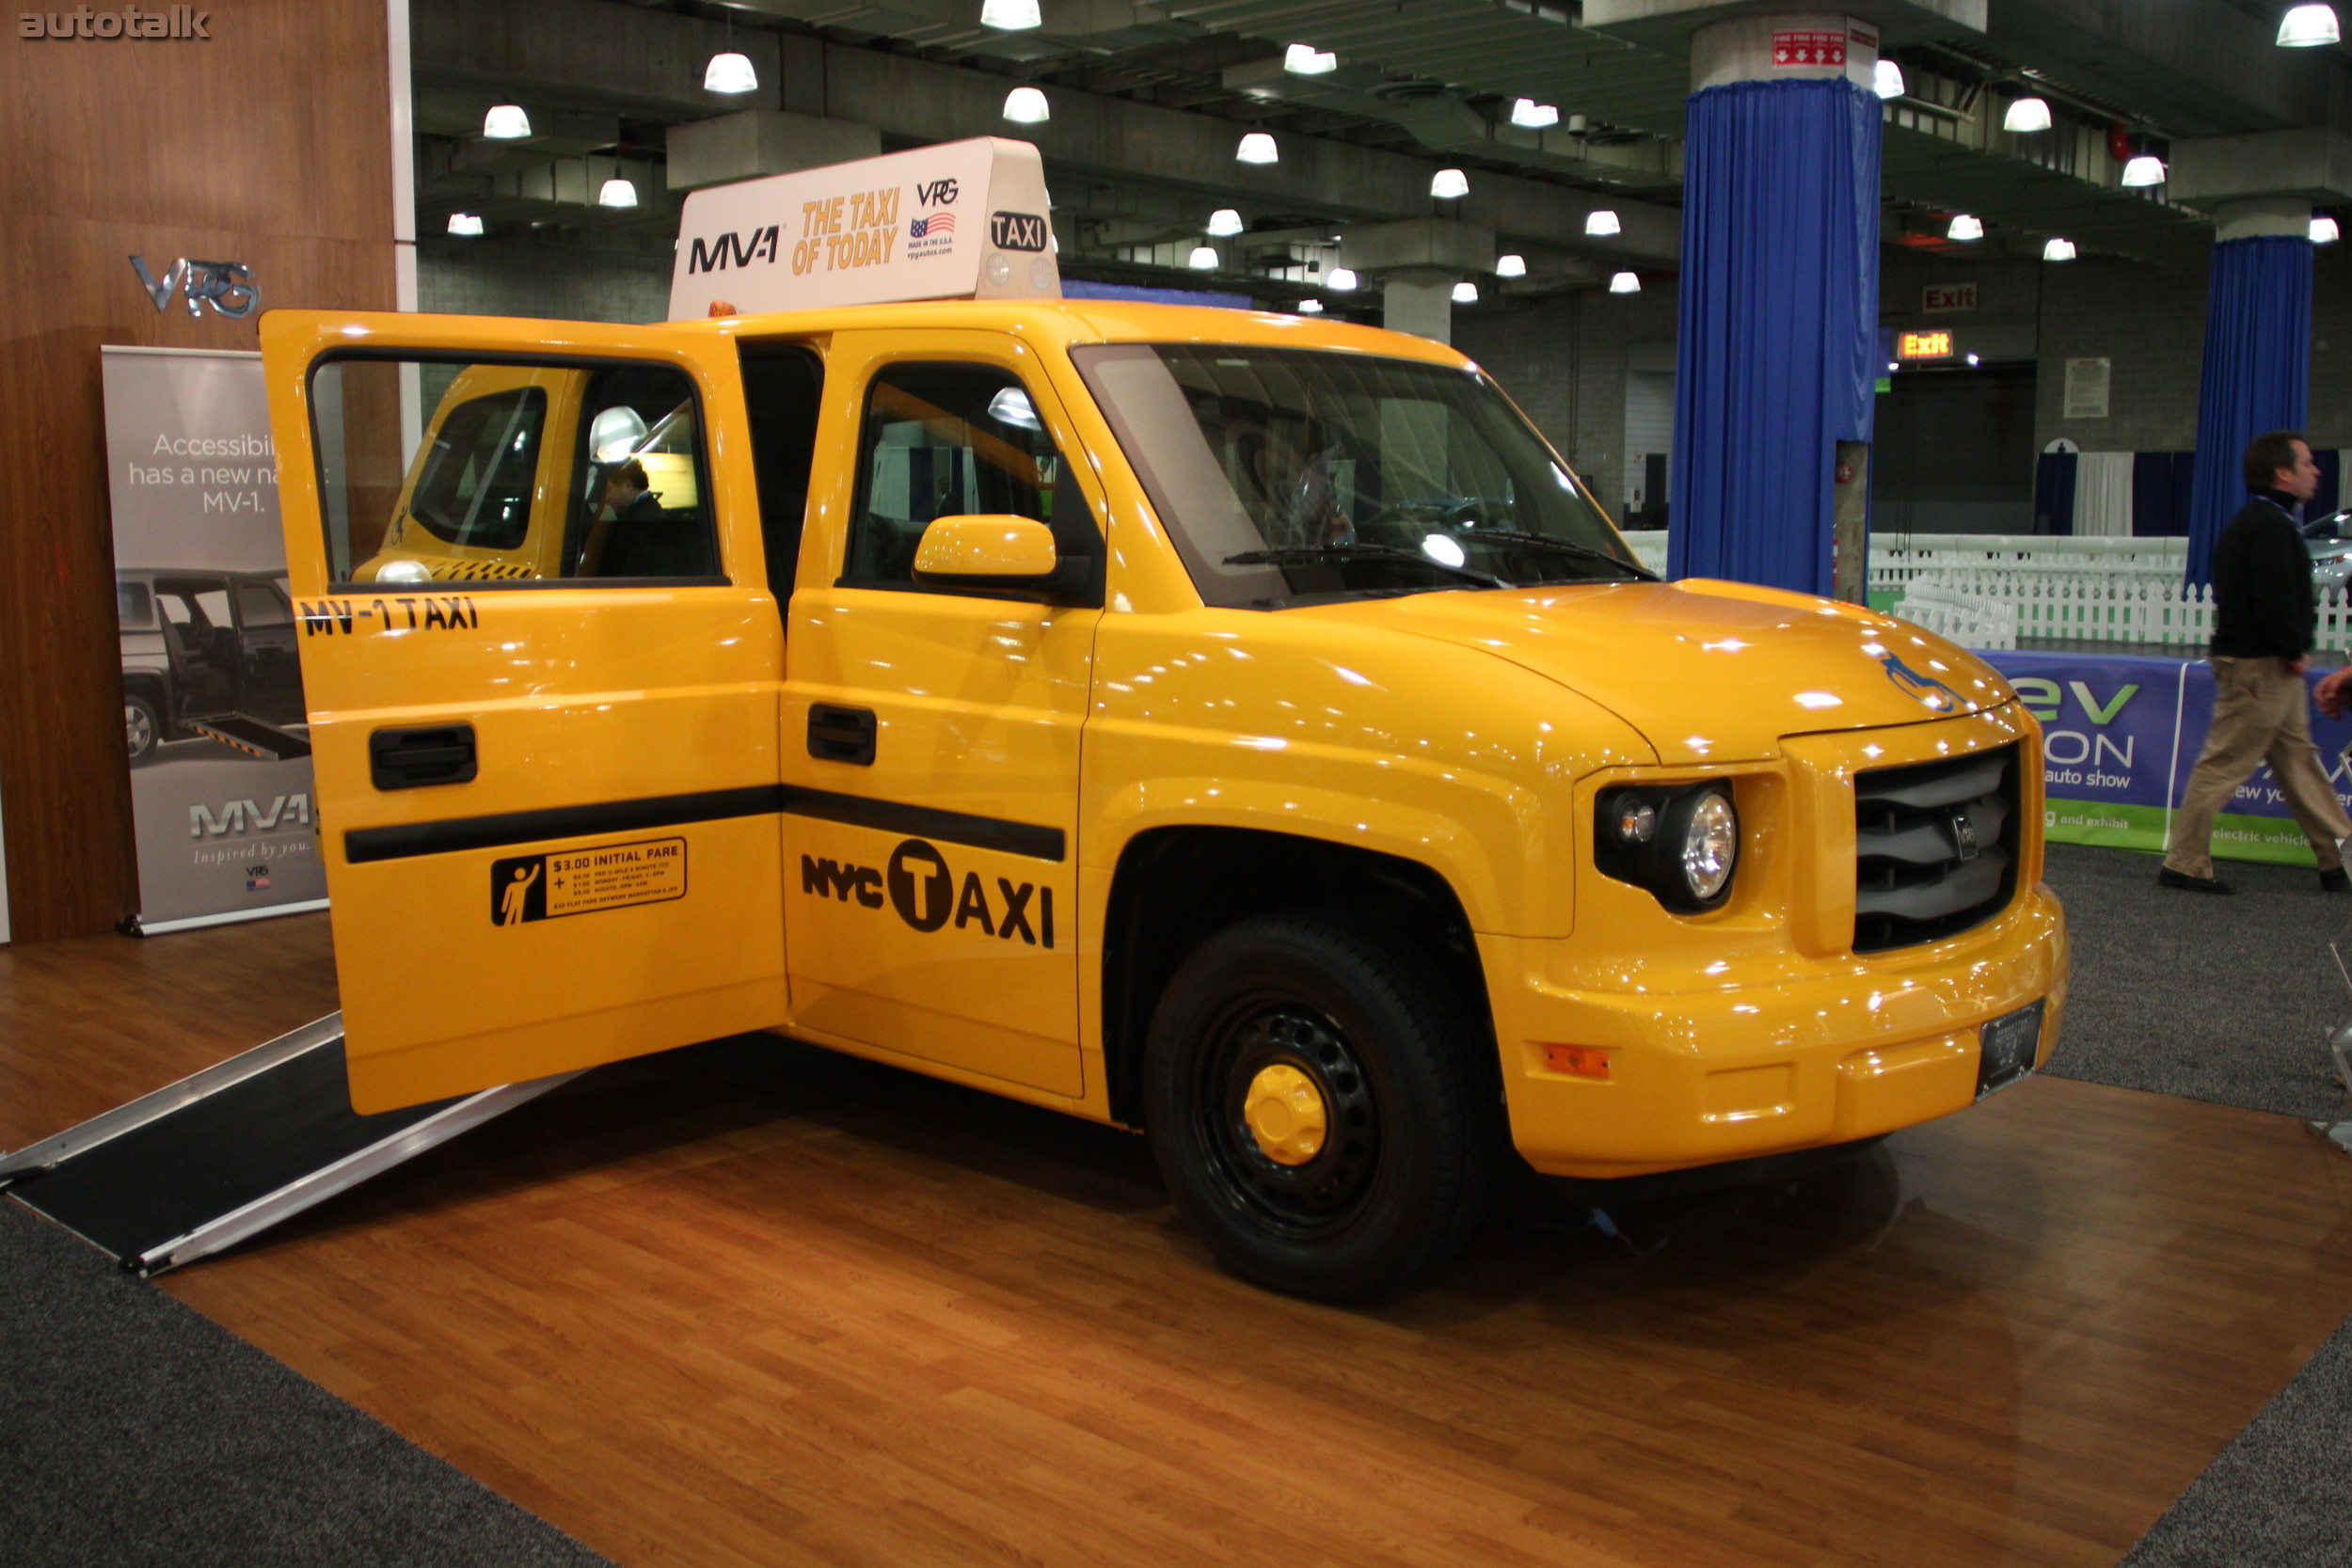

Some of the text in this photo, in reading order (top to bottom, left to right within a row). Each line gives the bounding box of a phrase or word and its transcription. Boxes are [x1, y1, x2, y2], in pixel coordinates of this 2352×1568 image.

[916, 178, 959, 207] VPG
[803, 187, 900, 237] THE TAXI
[992, 215, 1041, 247] TAXI
[792, 226, 898, 276] OF TODAY
[907, 247, 952, 261] vpgautos.com
[908, 240, 921, 248] MADE
[930, 238, 938, 246] THE
[1926, 288, 1975, 309] Exit
[1902, 332, 1949, 356] Exit
[153, 434, 275, 456] Accessibil
[130, 462, 174, 484] has
[181, 468, 195, 484] a
[201, 468, 250, 484] new
[203, 491, 264, 513] MV-1.
[395, 596, 478, 631] TAXI
[2045, 768, 2131, 788] auto show
[2060, 814, 2083, 826] and
[2087, 815, 2129, 830] exhibit
[2212, 828, 2260, 842] electric
[194, 843, 310, 865] Inspired by you.
[553, 857, 590, 873] $3.00
[595, 851, 641, 866] INITIAL
[647, 847, 677, 860] FARE
[802, 854, 883, 910] NYC
